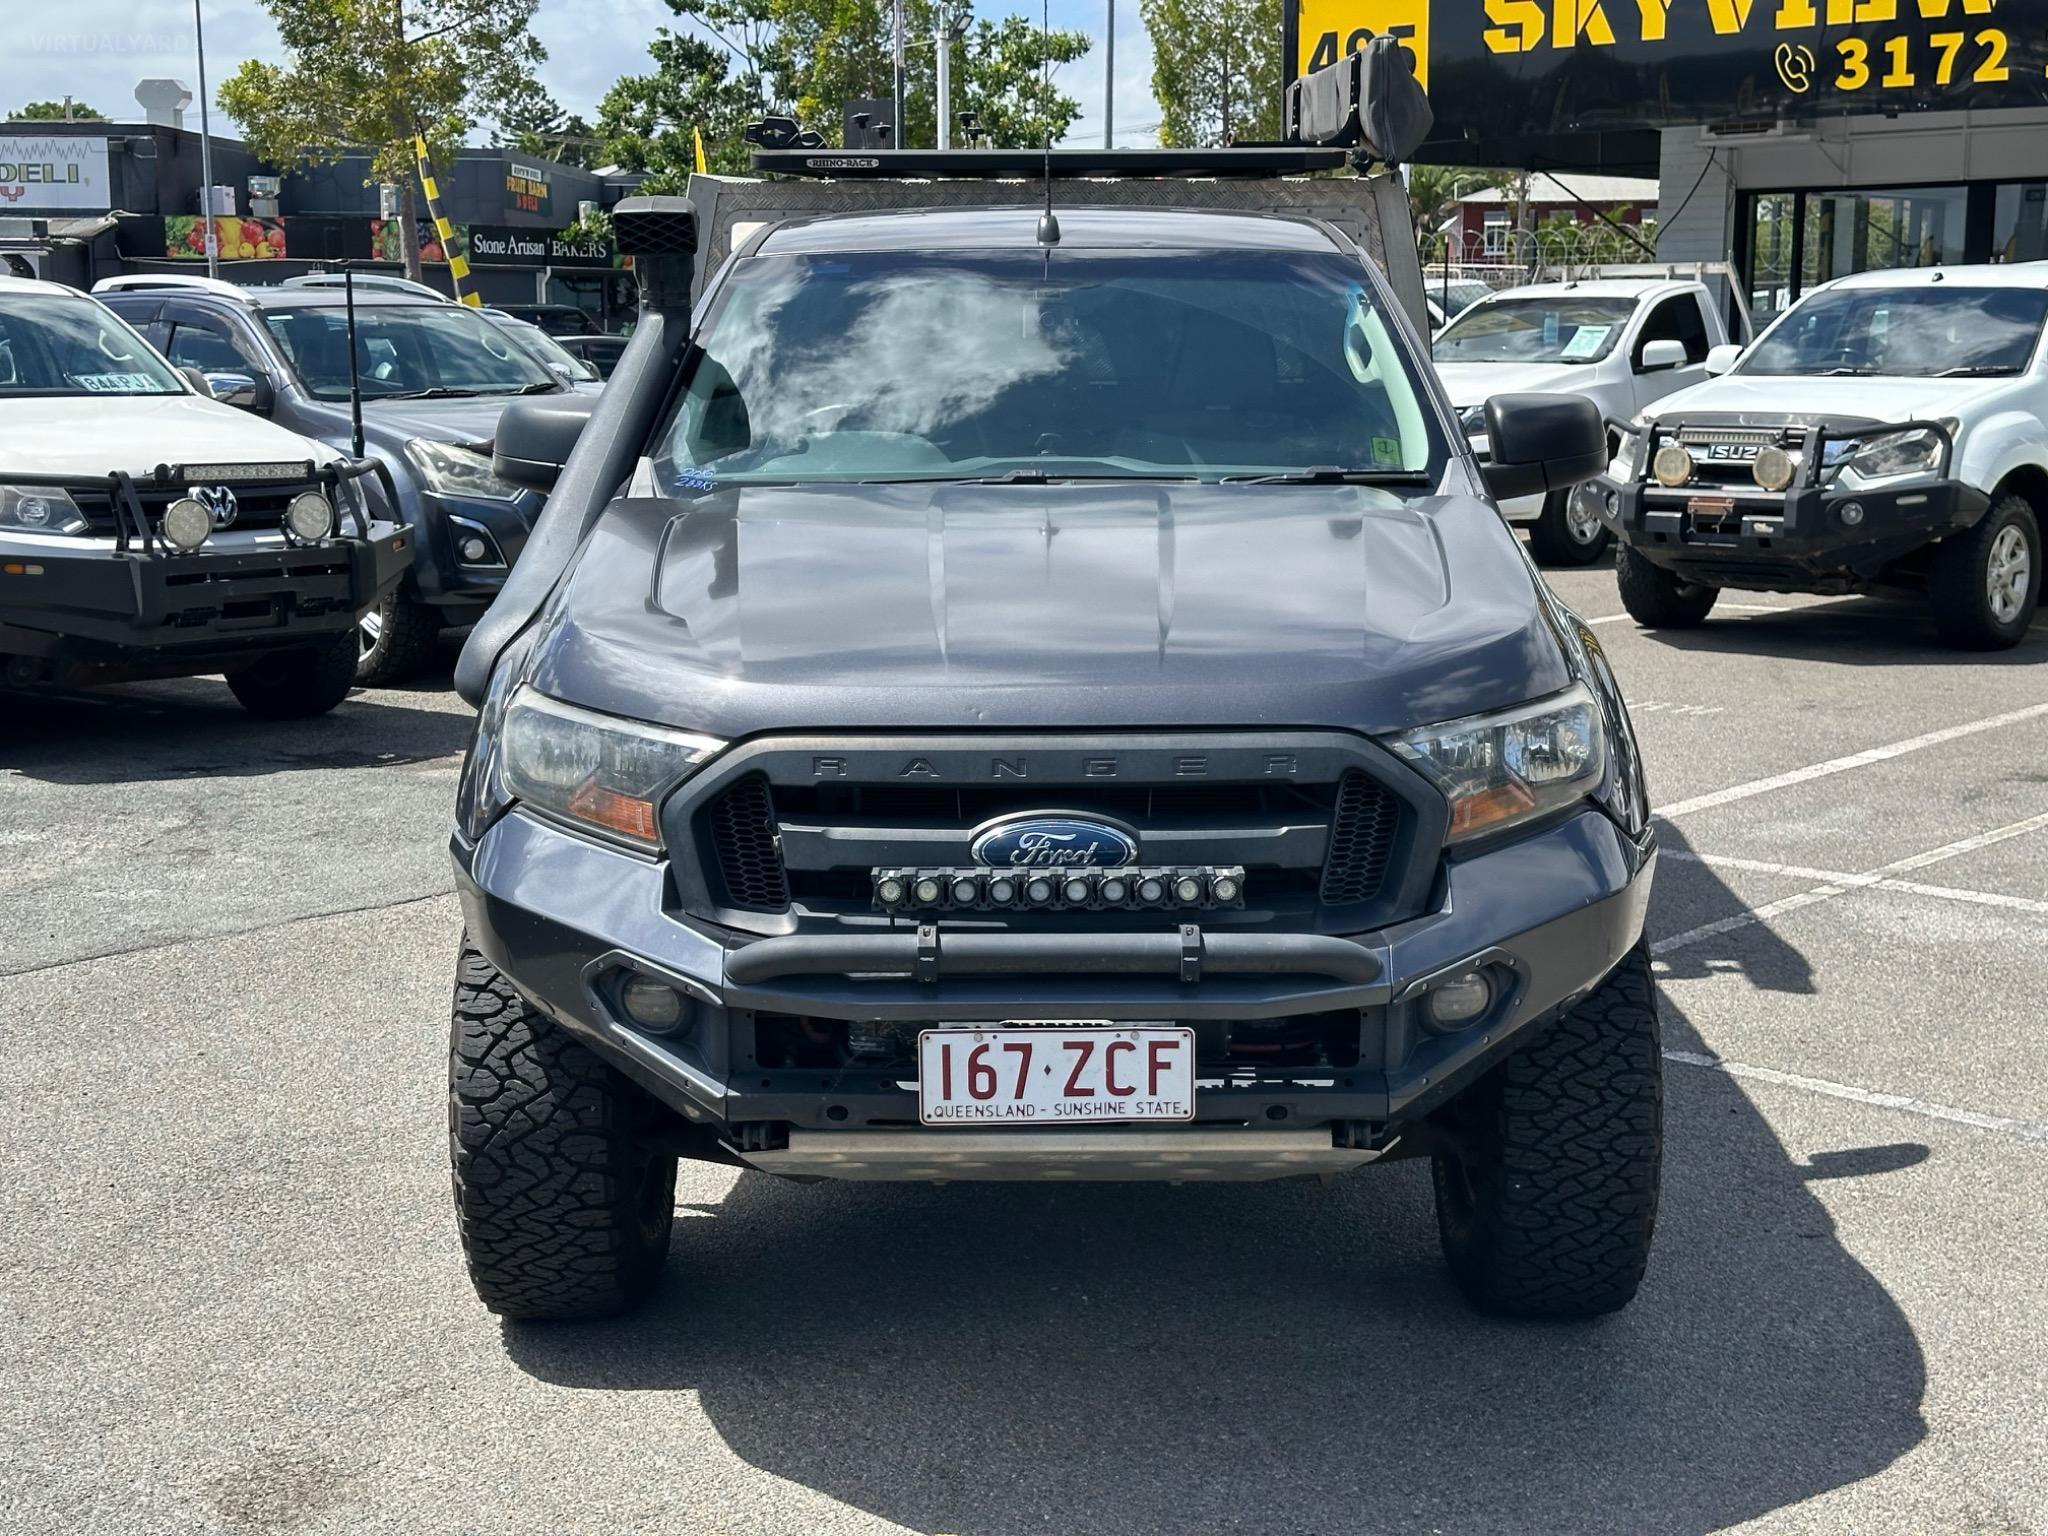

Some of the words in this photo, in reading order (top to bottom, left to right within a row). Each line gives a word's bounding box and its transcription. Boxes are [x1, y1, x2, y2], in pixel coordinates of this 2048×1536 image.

[1834, 28, 2009, 91] 3172
[812, 158, 874, 168] RHINO-RACK
[474, 233, 505, 254] Stone
[1709, 445, 1763, 459] ISUZ
[813, 754, 1298, 778] RANGER
[1010, 832, 1099, 865] Ford
[942, 1042, 1033, 1100] 167
[1062, 1040, 1180, 1097] ZCF
[934, 1103, 1035, 1119] QUEENSLAND
[1053, 1102, 1126, 1116] SUNSHINE
[1135, 1101, 1182, 1114] STATE
